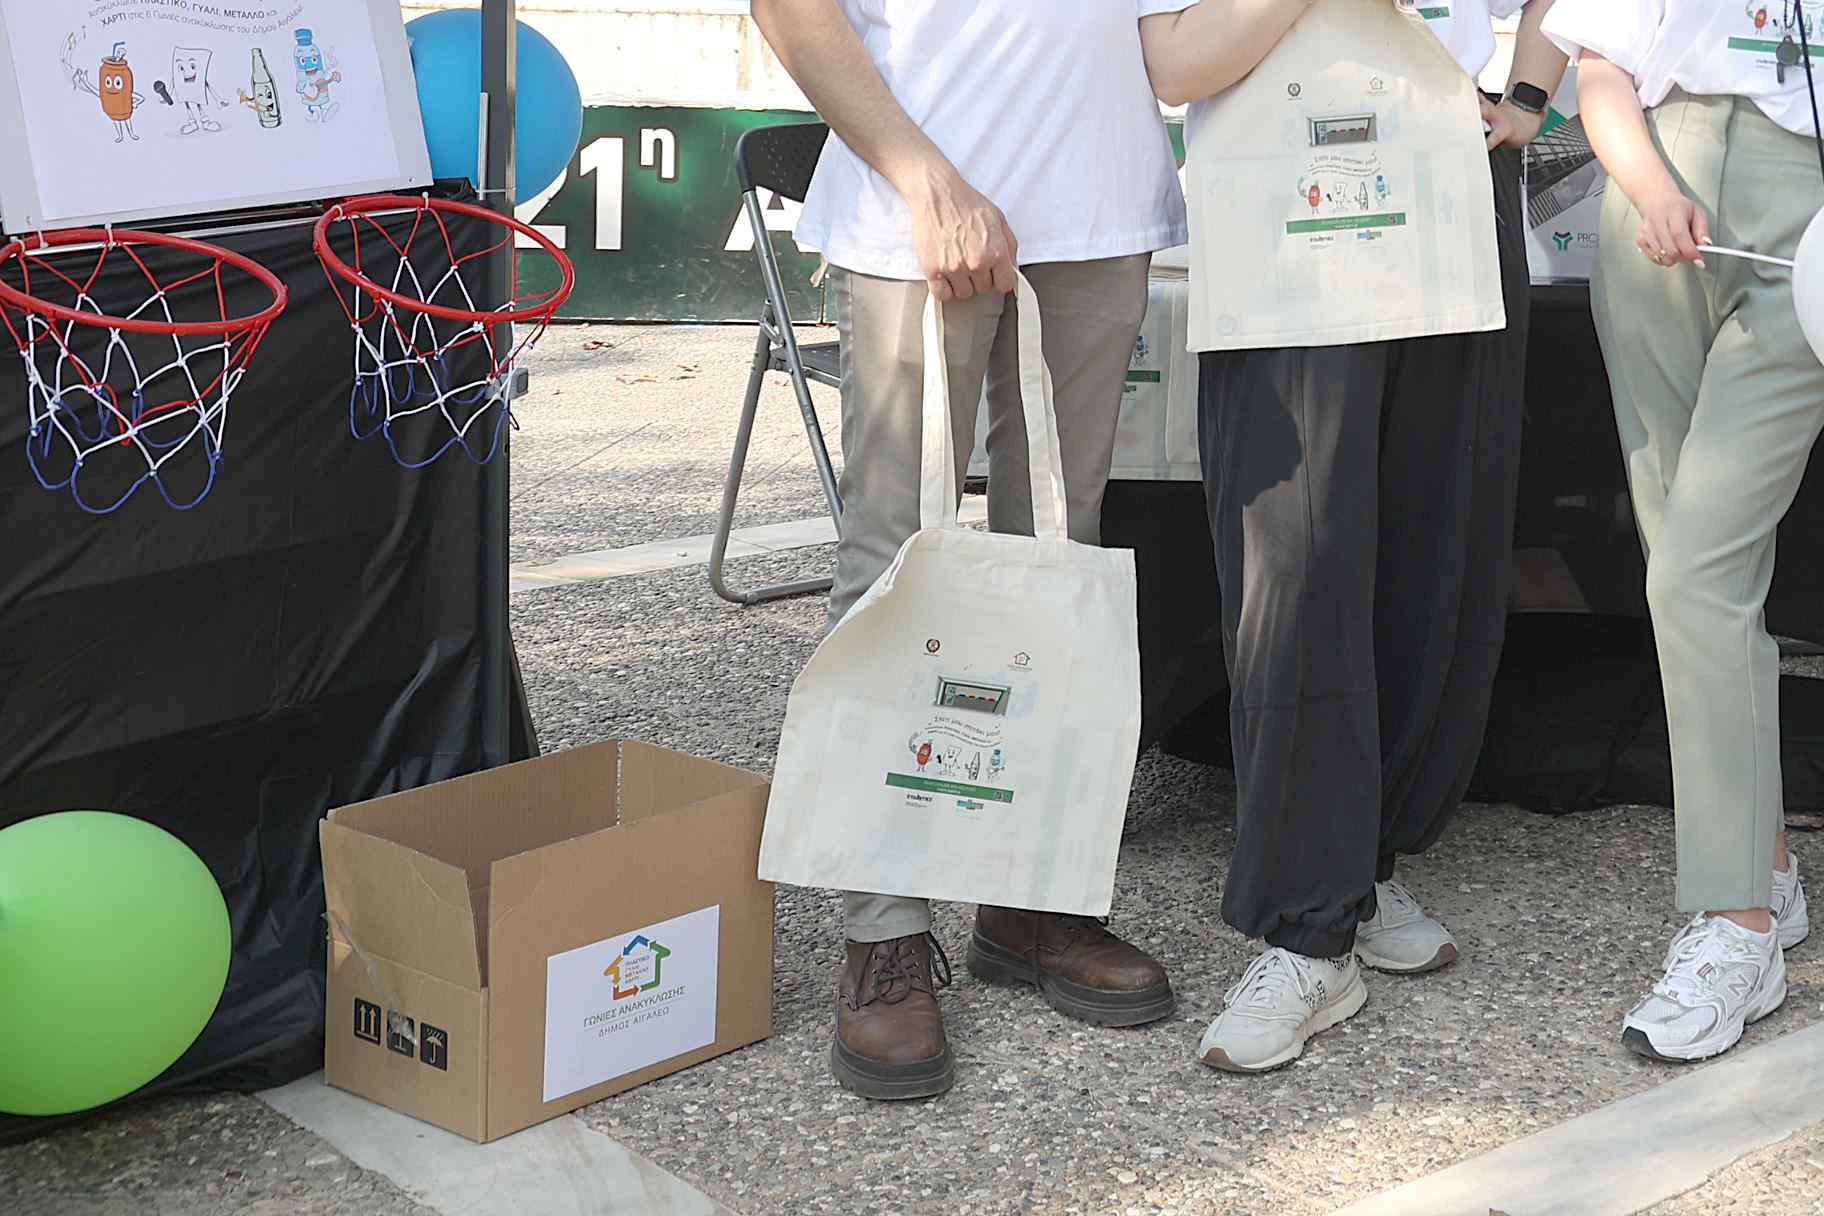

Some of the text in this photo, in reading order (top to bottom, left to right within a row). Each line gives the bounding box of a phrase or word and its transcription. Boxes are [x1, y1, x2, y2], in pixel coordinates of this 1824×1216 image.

[101, 12, 127, 27] ΧΑΡΤΙ
[223, 9, 266, 20] ΜΕΤΑΛΛΟ
[583, 985, 687, 1028] ΓΩΝΙΕΣ ΑΝΑΚΥΚΛΩΣΗΣ
[598, 1006, 670, 1038] ΔΗΜΟΣ ΑΙΓΑΛΕΩ
